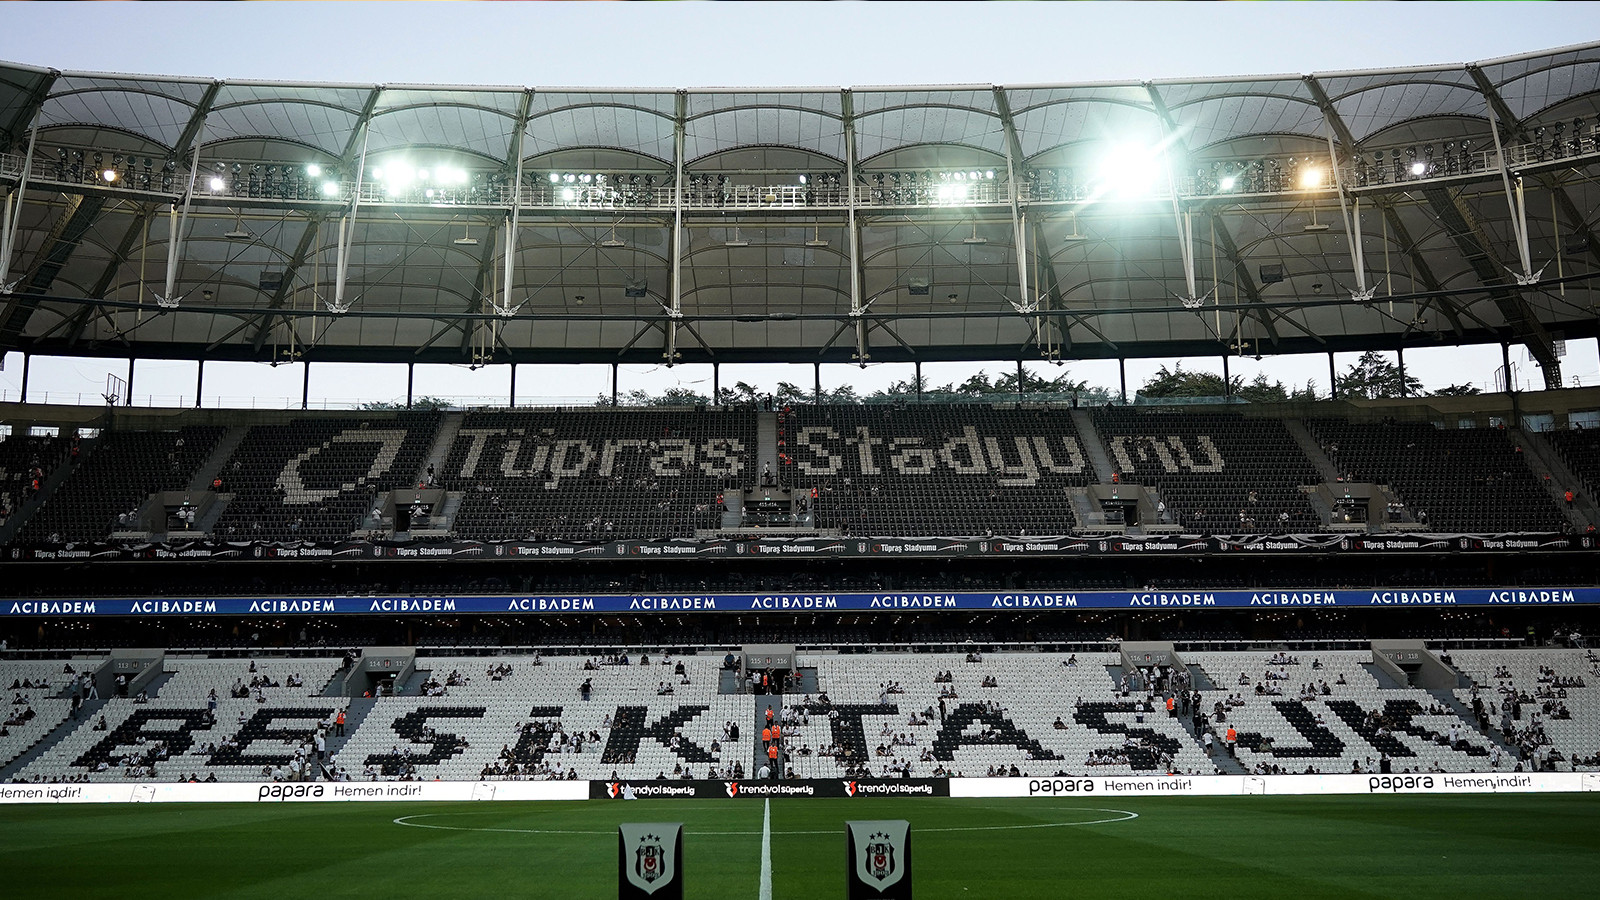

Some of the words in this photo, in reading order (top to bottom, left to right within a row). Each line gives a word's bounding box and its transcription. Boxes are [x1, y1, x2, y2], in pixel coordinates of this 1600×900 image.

[759, 545, 781, 554] Tüpraş
[782, 545, 815, 553] Stadyumu
[880, 544, 902, 553] Tüpraş
[904, 544, 936, 552] Stadyumu
[1002, 543, 1024, 552] Tüpraş
[1026, 543, 1058, 551] Stadyumu
[1122, 543, 1144, 551] Tüpraş
[1363, 541, 1384, 549] Tüpraş
[1387, 541, 1418, 549] Stadyumu
[1482, 540, 1504, 548] Tüpraş
[1506, 540, 1538, 548] Stadyumu
[277, 548, 299, 557] Tüpraş
[300, 548, 332, 556] Stadyumu
[396, 547, 418, 556] Tüpraş
[419, 547, 452, 555] Stadyumu
[517, 547, 540, 555] Tüpraş
[541, 547, 574, 555] Stadyumu
[639, 546, 662, 554] Tüpraş
[663, 546, 695, 554] Stadyumu
[751, 597, 837, 608] ACIBADEM
[870, 595, 956, 607] ACIBADEM
[991, 595, 1078, 606] ACIBADEM
[1130, 594, 1216, 605] ACIBADEM
[1250, 593, 1336, 605] ACIBADEM
[1371, 592, 1456, 603] ACIBADEM
[1489, 591, 1574, 603] ACIBADEM
[10, 602, 95, 613] ACIBADEM
[131, 601, 216, 612] ACIBADEM
[249, 600, 335, 612] ACIBADEM
[370, 599, 456, 611] ACIBADEM
[508, 598, 594, 610] ACIBADEM
[630, 597, 716, 609] ACIBADEM
[1236, 700, 1490, 757] JK
[1029, 779, 1094, 795] papara
[1104, 780, 1154, 791] Hemen
[1157, 779, 1192, 790] indir!
[1369, 776, 1434, 792] papara
[1444, 777, 1494, 787] Hemen
[1496, 775, 1532, 787] indir!
[258, 785, 324, 802] papara
[334, 786, 383, 797] Hemen
[386, 785, 422, 796] indir!
[620, 785, 662, 796] tendyol
